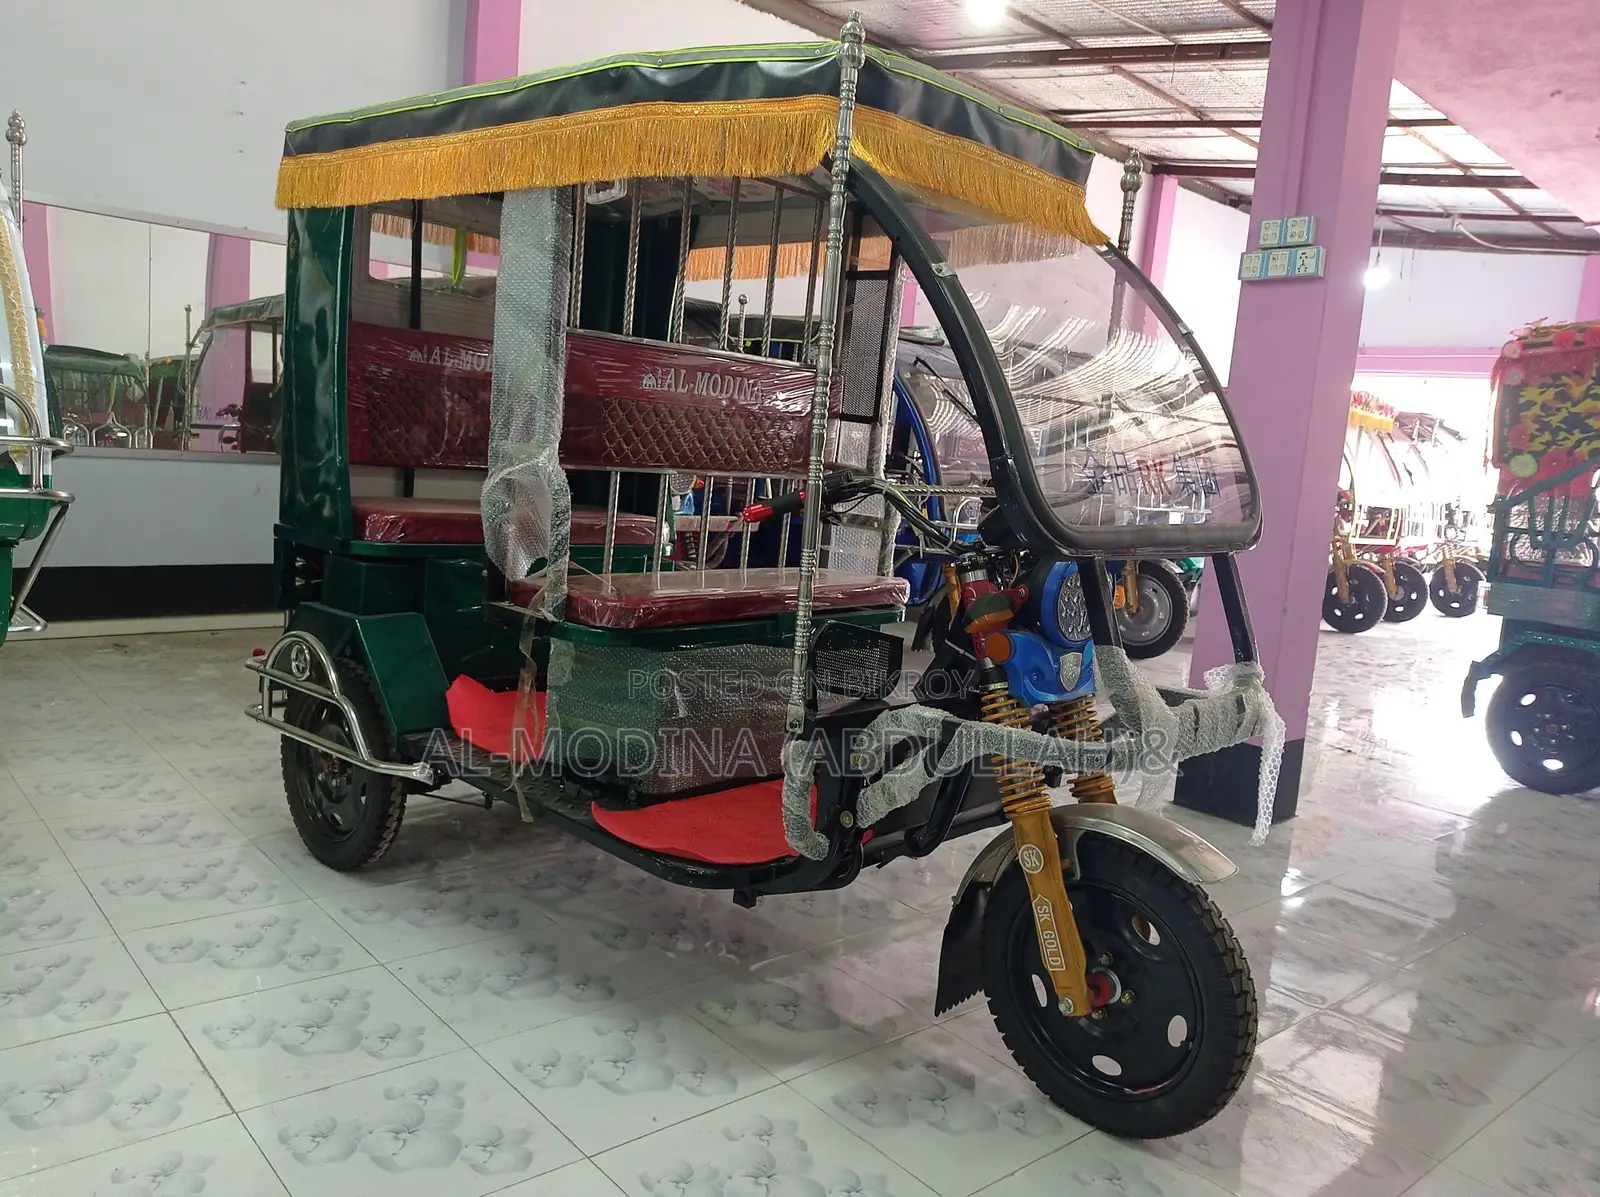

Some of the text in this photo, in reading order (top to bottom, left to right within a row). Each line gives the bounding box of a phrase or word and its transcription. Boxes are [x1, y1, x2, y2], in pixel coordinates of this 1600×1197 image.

[662, 368, 761, 403] AL-MODINA
[1022, 850, 1041, 869] SK
[1036, 905, 1063, 967] SK GOLD
